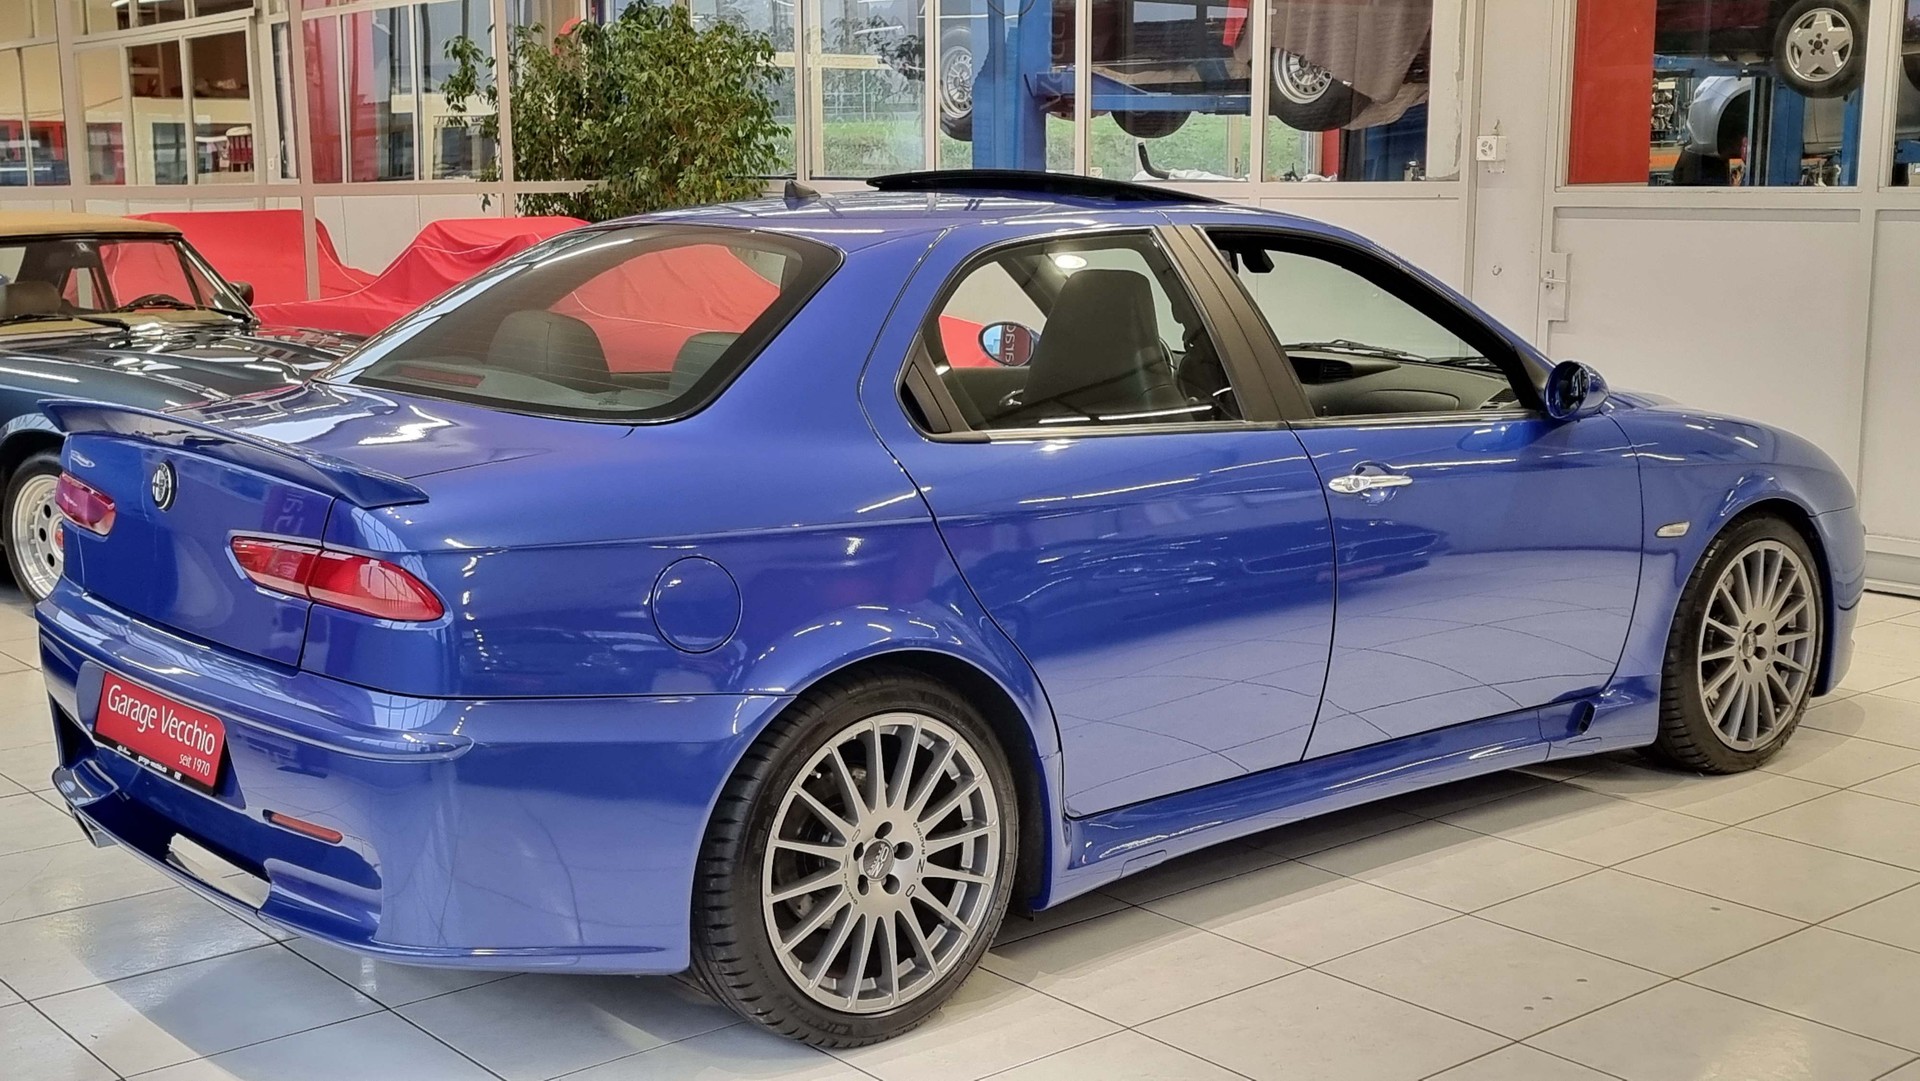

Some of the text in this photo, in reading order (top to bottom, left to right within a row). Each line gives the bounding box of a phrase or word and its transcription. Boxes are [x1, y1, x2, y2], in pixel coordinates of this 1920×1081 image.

[107, 684, 216, 756] Garage Vecchio
[178, 753, 192, 769] seit
[192, 757, 211, 777] 1970
